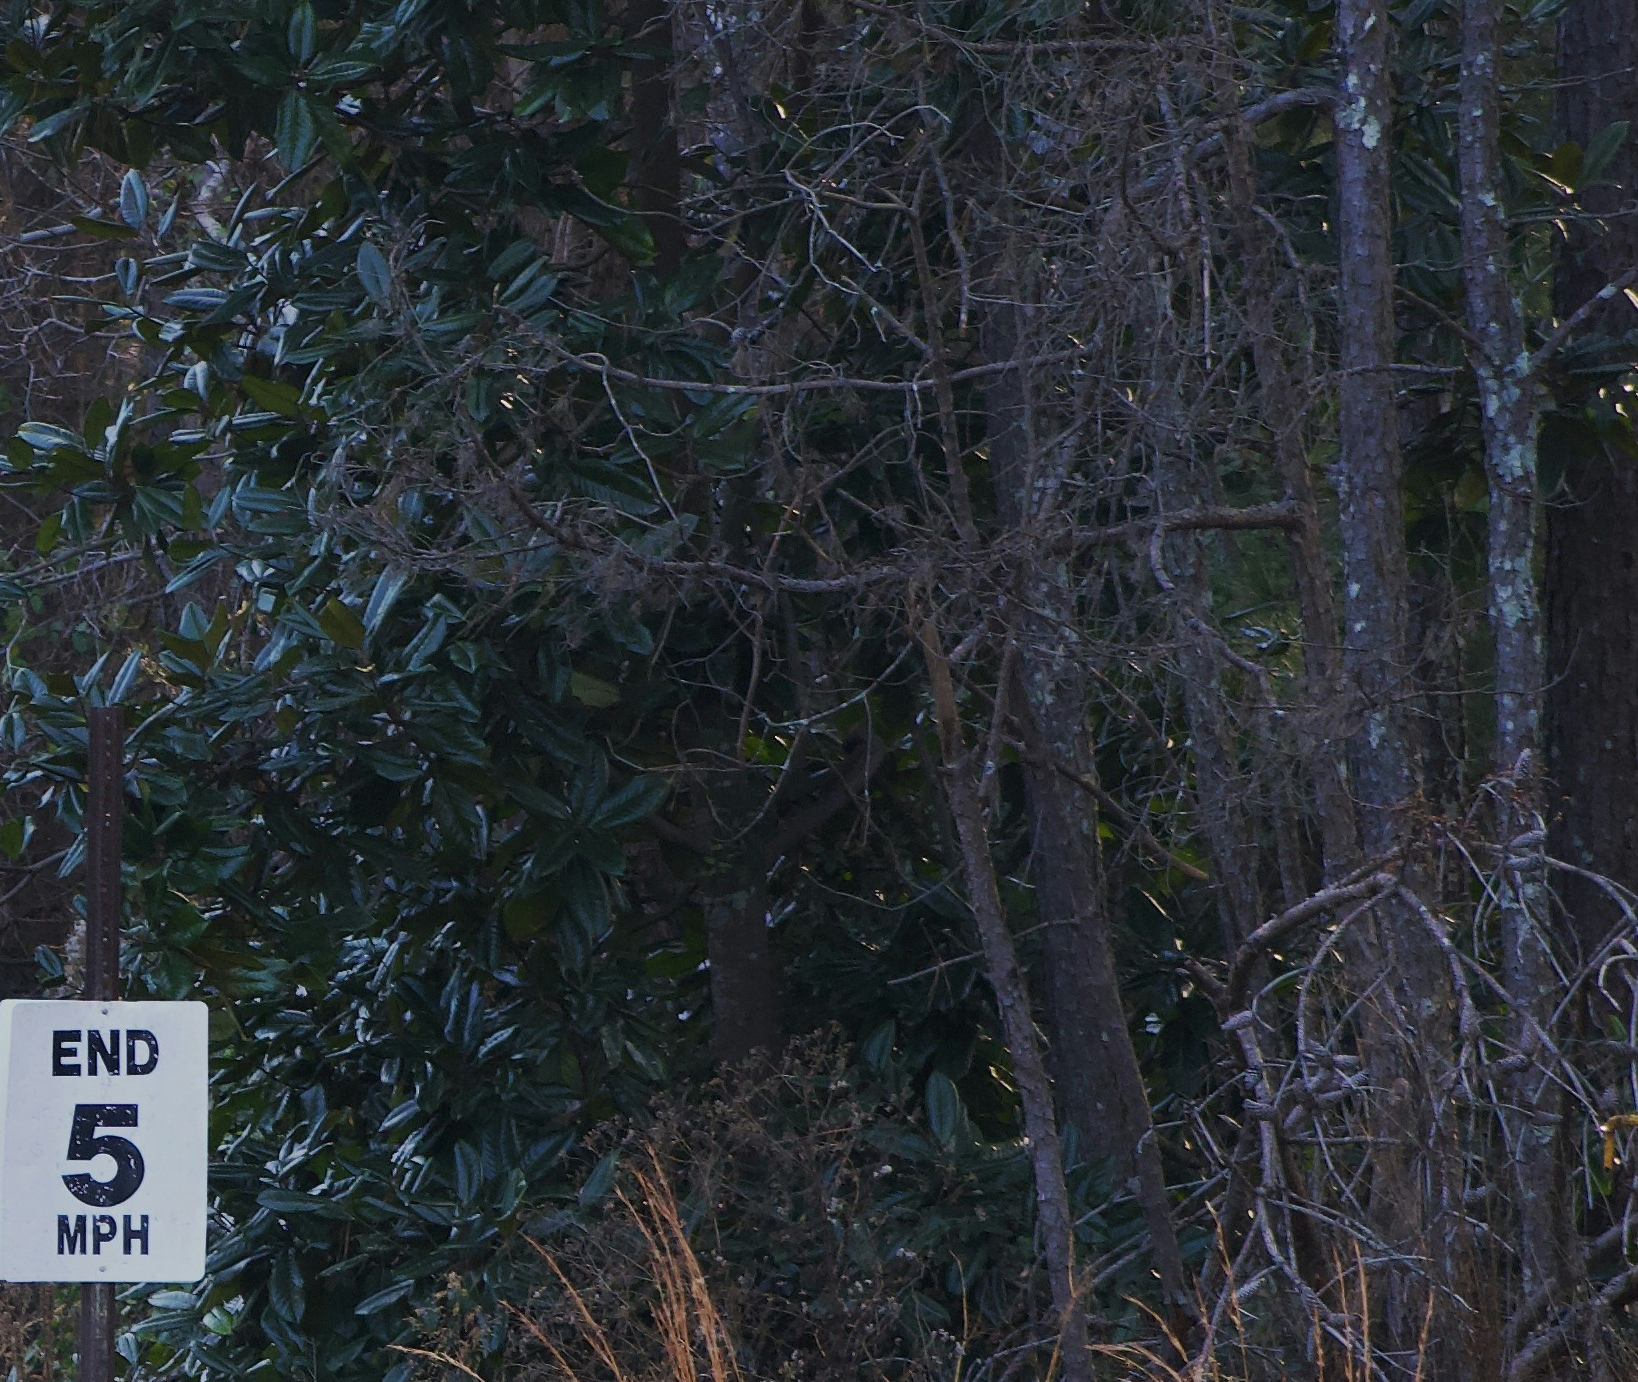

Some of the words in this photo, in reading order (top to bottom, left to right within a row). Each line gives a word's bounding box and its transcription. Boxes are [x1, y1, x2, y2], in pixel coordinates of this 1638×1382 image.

[52, 1030, 159, 1076] END
[62, 1104, 145, 1207] 5
[57, 1214, 149, 1255] MPH
